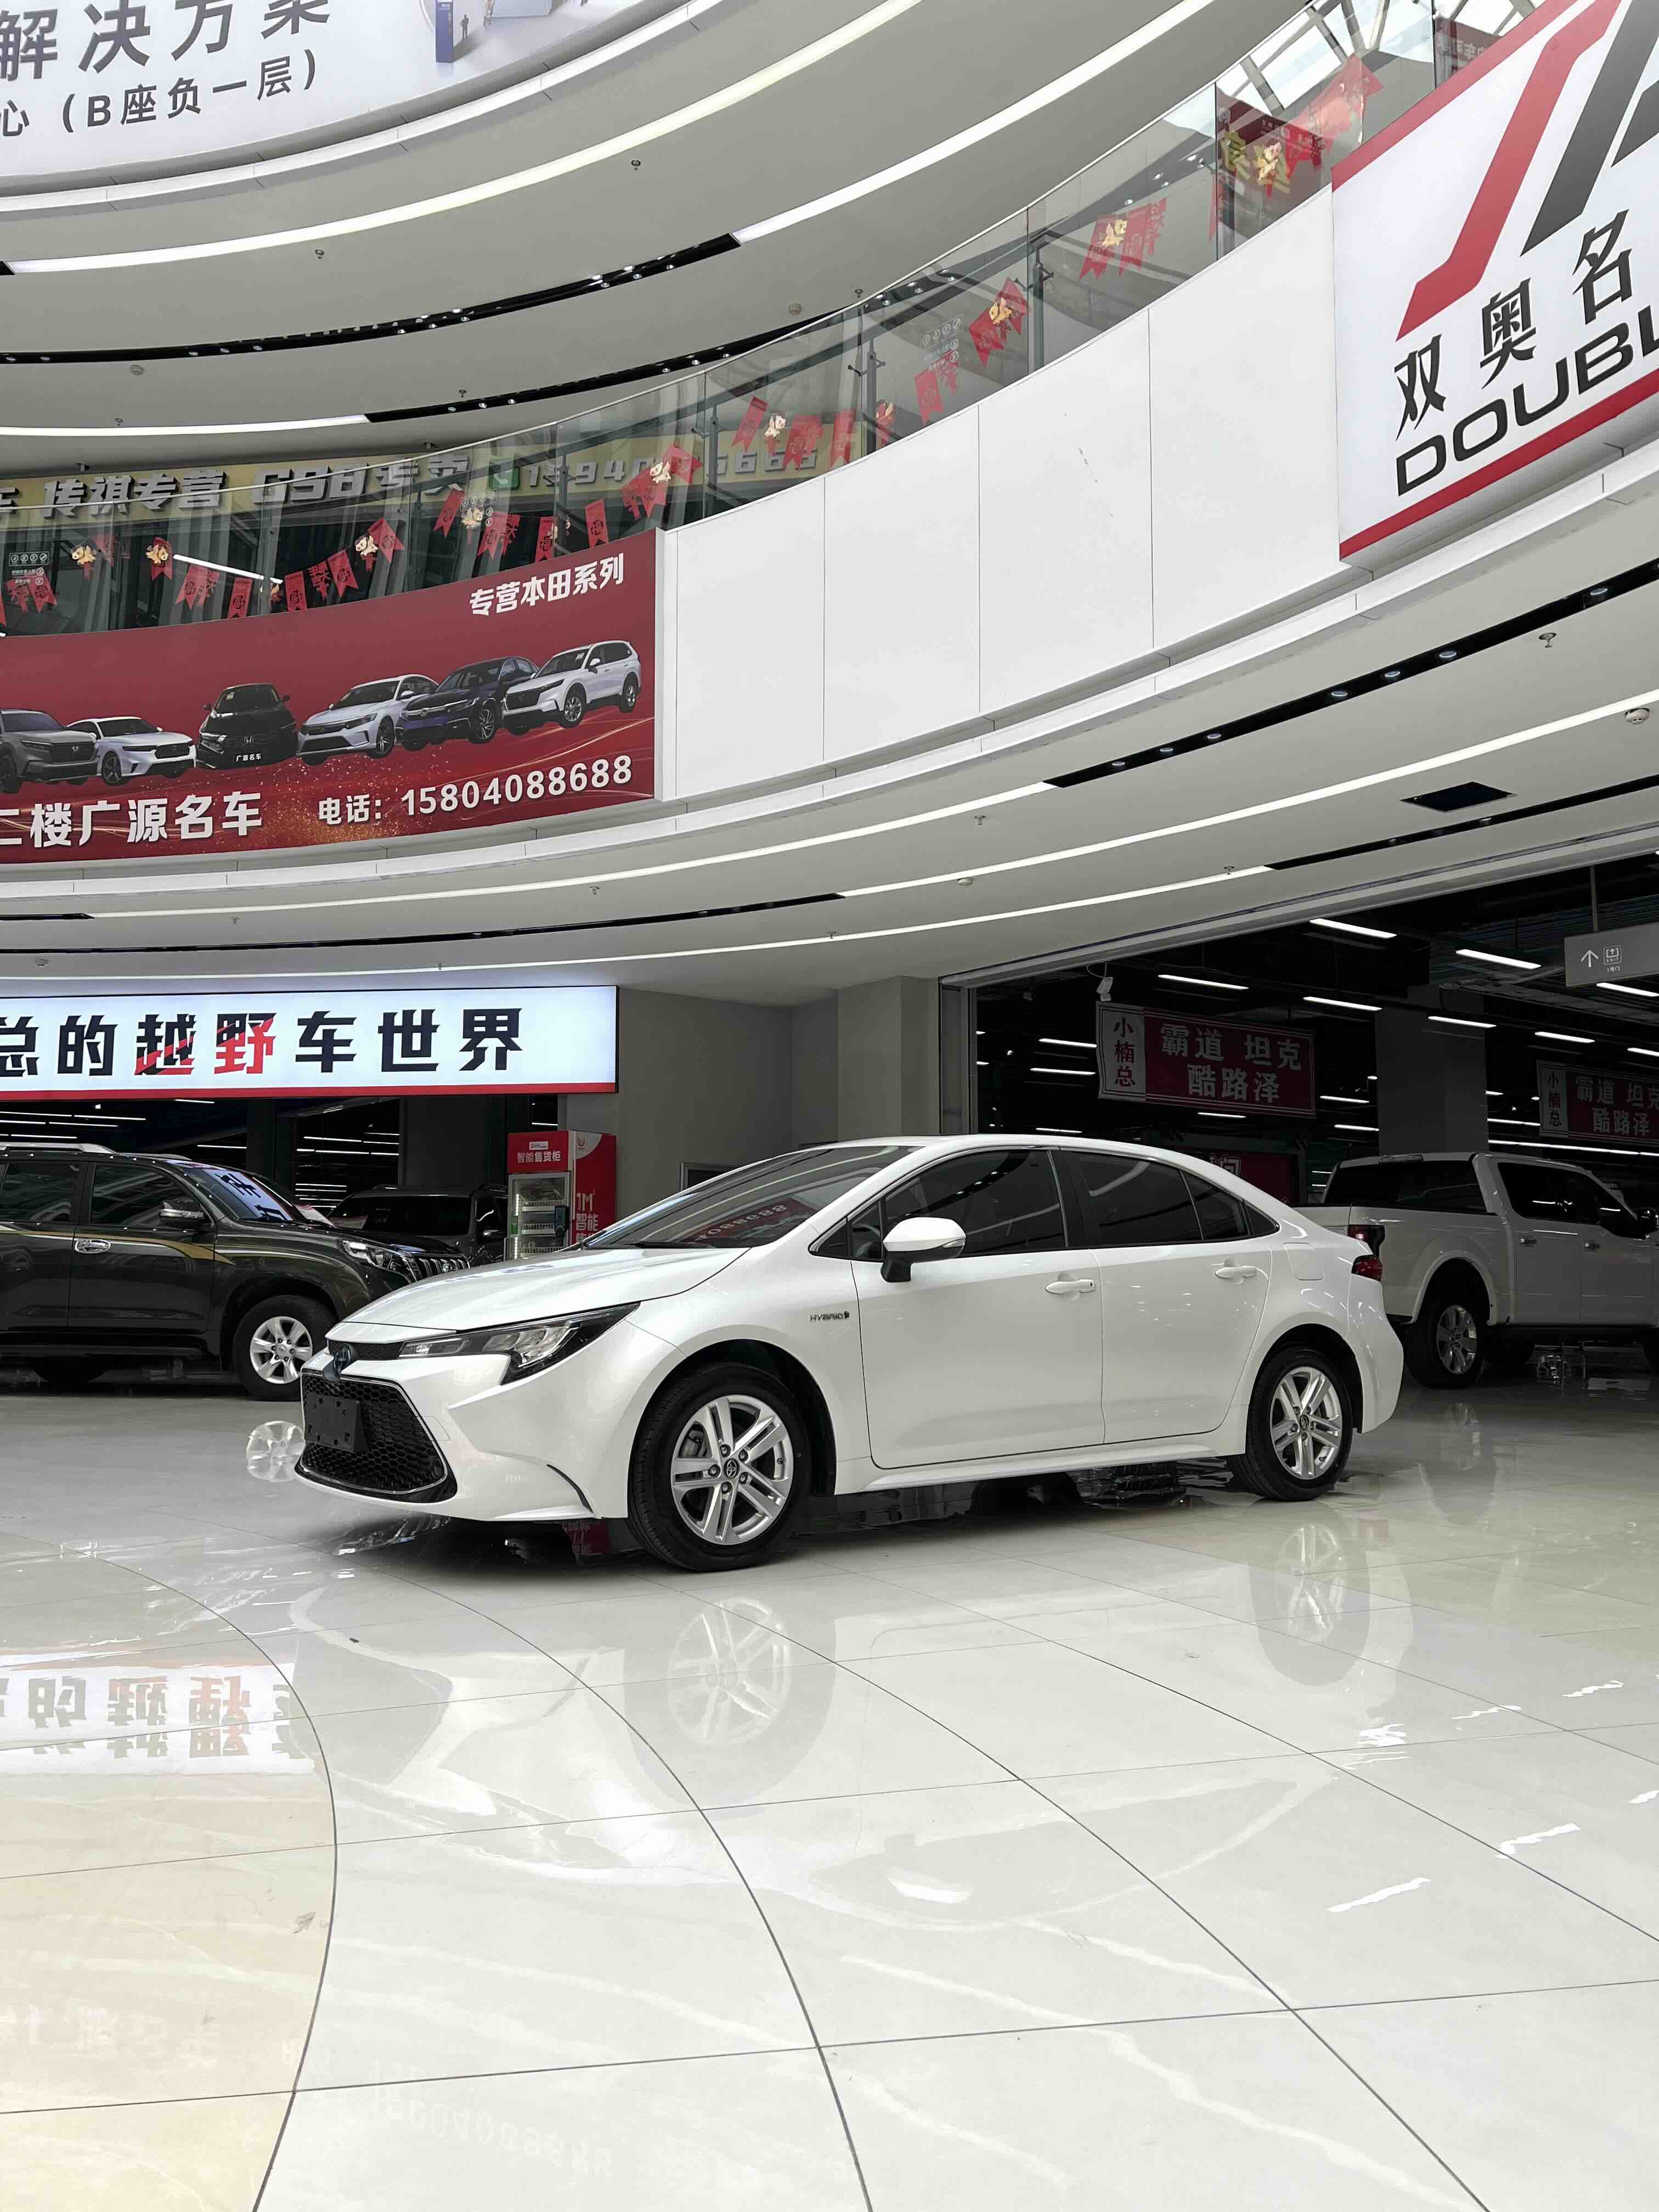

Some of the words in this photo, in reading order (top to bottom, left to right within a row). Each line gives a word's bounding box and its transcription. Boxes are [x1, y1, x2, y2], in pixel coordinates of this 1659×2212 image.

[1395, 208, 1633, 442] 双奥名
[470, 552, 624, 617] 专营本田系列
[0, 791, 262, 848] 二楼广源名车
[401, 755, 632, 816] 15804088688
[0, 1008, 523, 1075] 总的越野车世界
[1113, 1017, 1137, 1088] 小楠总
[1160, 1023, 1224, 1063] 霸道
[1244, 1034, 1302, 1071] 坦克
[1186, 1063, 1280, 1103] 酷路泽
[1592, 1107, 1651, 1137] 酷路泽
[517, 1151, 561, 1163] 智能售货柜
[576, 1213, 599, 1231] 智能
